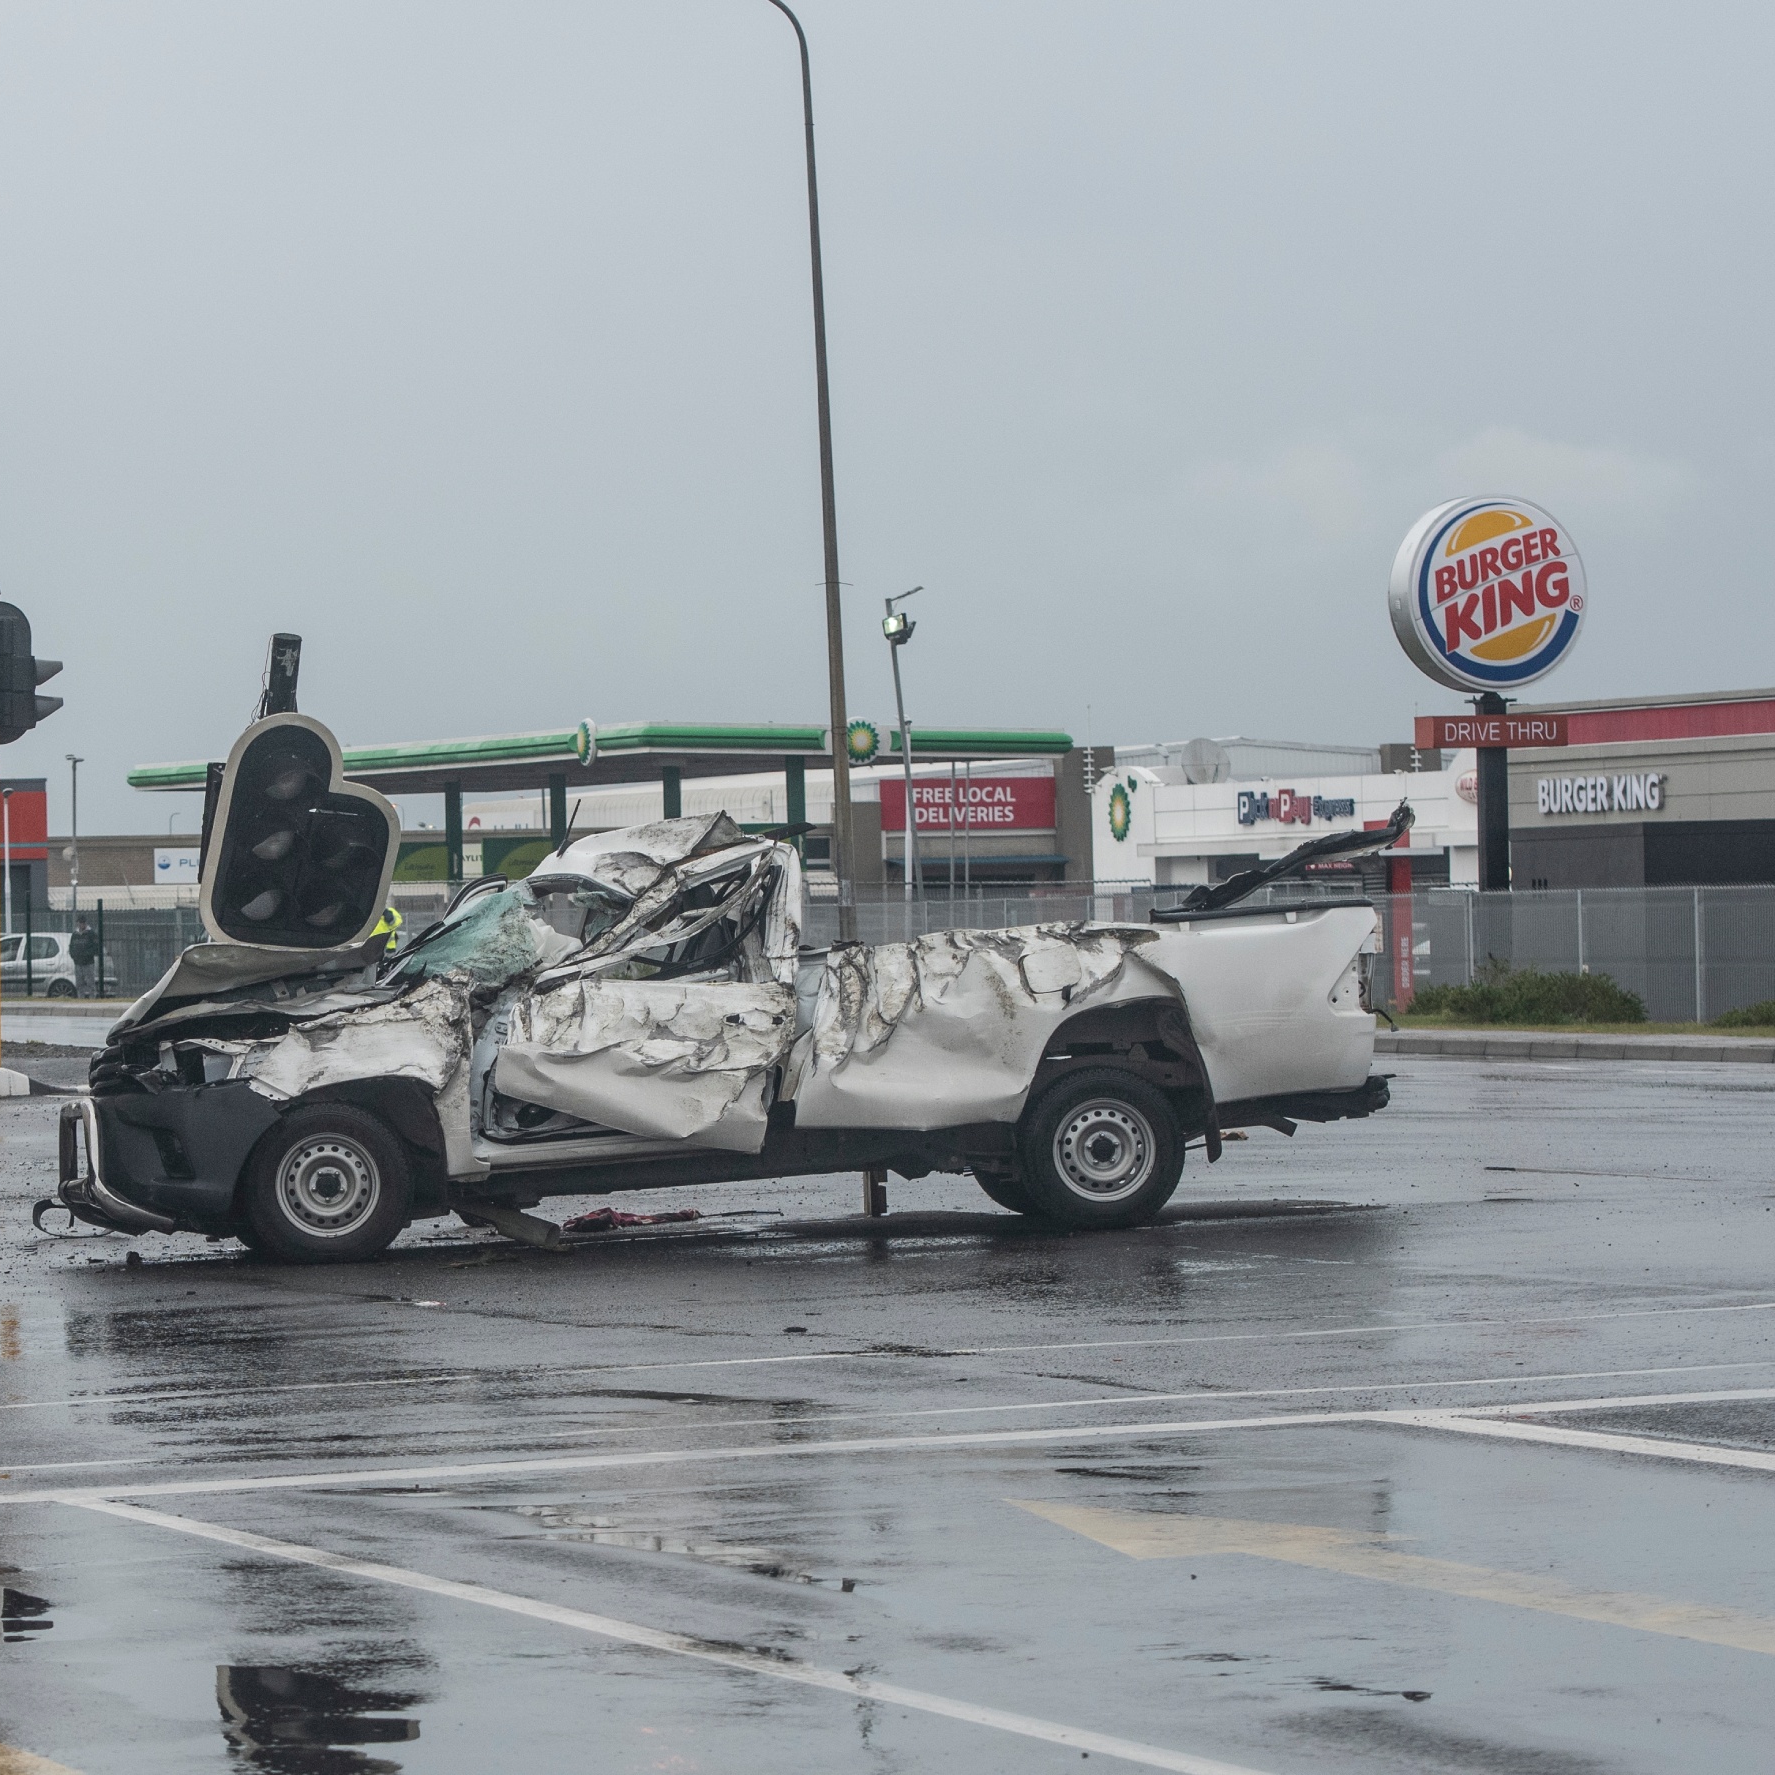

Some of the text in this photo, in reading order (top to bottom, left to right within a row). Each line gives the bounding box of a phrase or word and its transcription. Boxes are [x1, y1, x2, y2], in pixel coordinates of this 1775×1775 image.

[1434, 527, 1561, 605] BURGER
[1444, 561, 1570, 654] KING
[1445, 721, 1557, 742] DRIVE THRU
[912, 787, 1016, 803] FREE LOCAL
[1538, 773, 1662, 814] BURGER KING
[914, 806, 1015, 823] DELIVERIES
